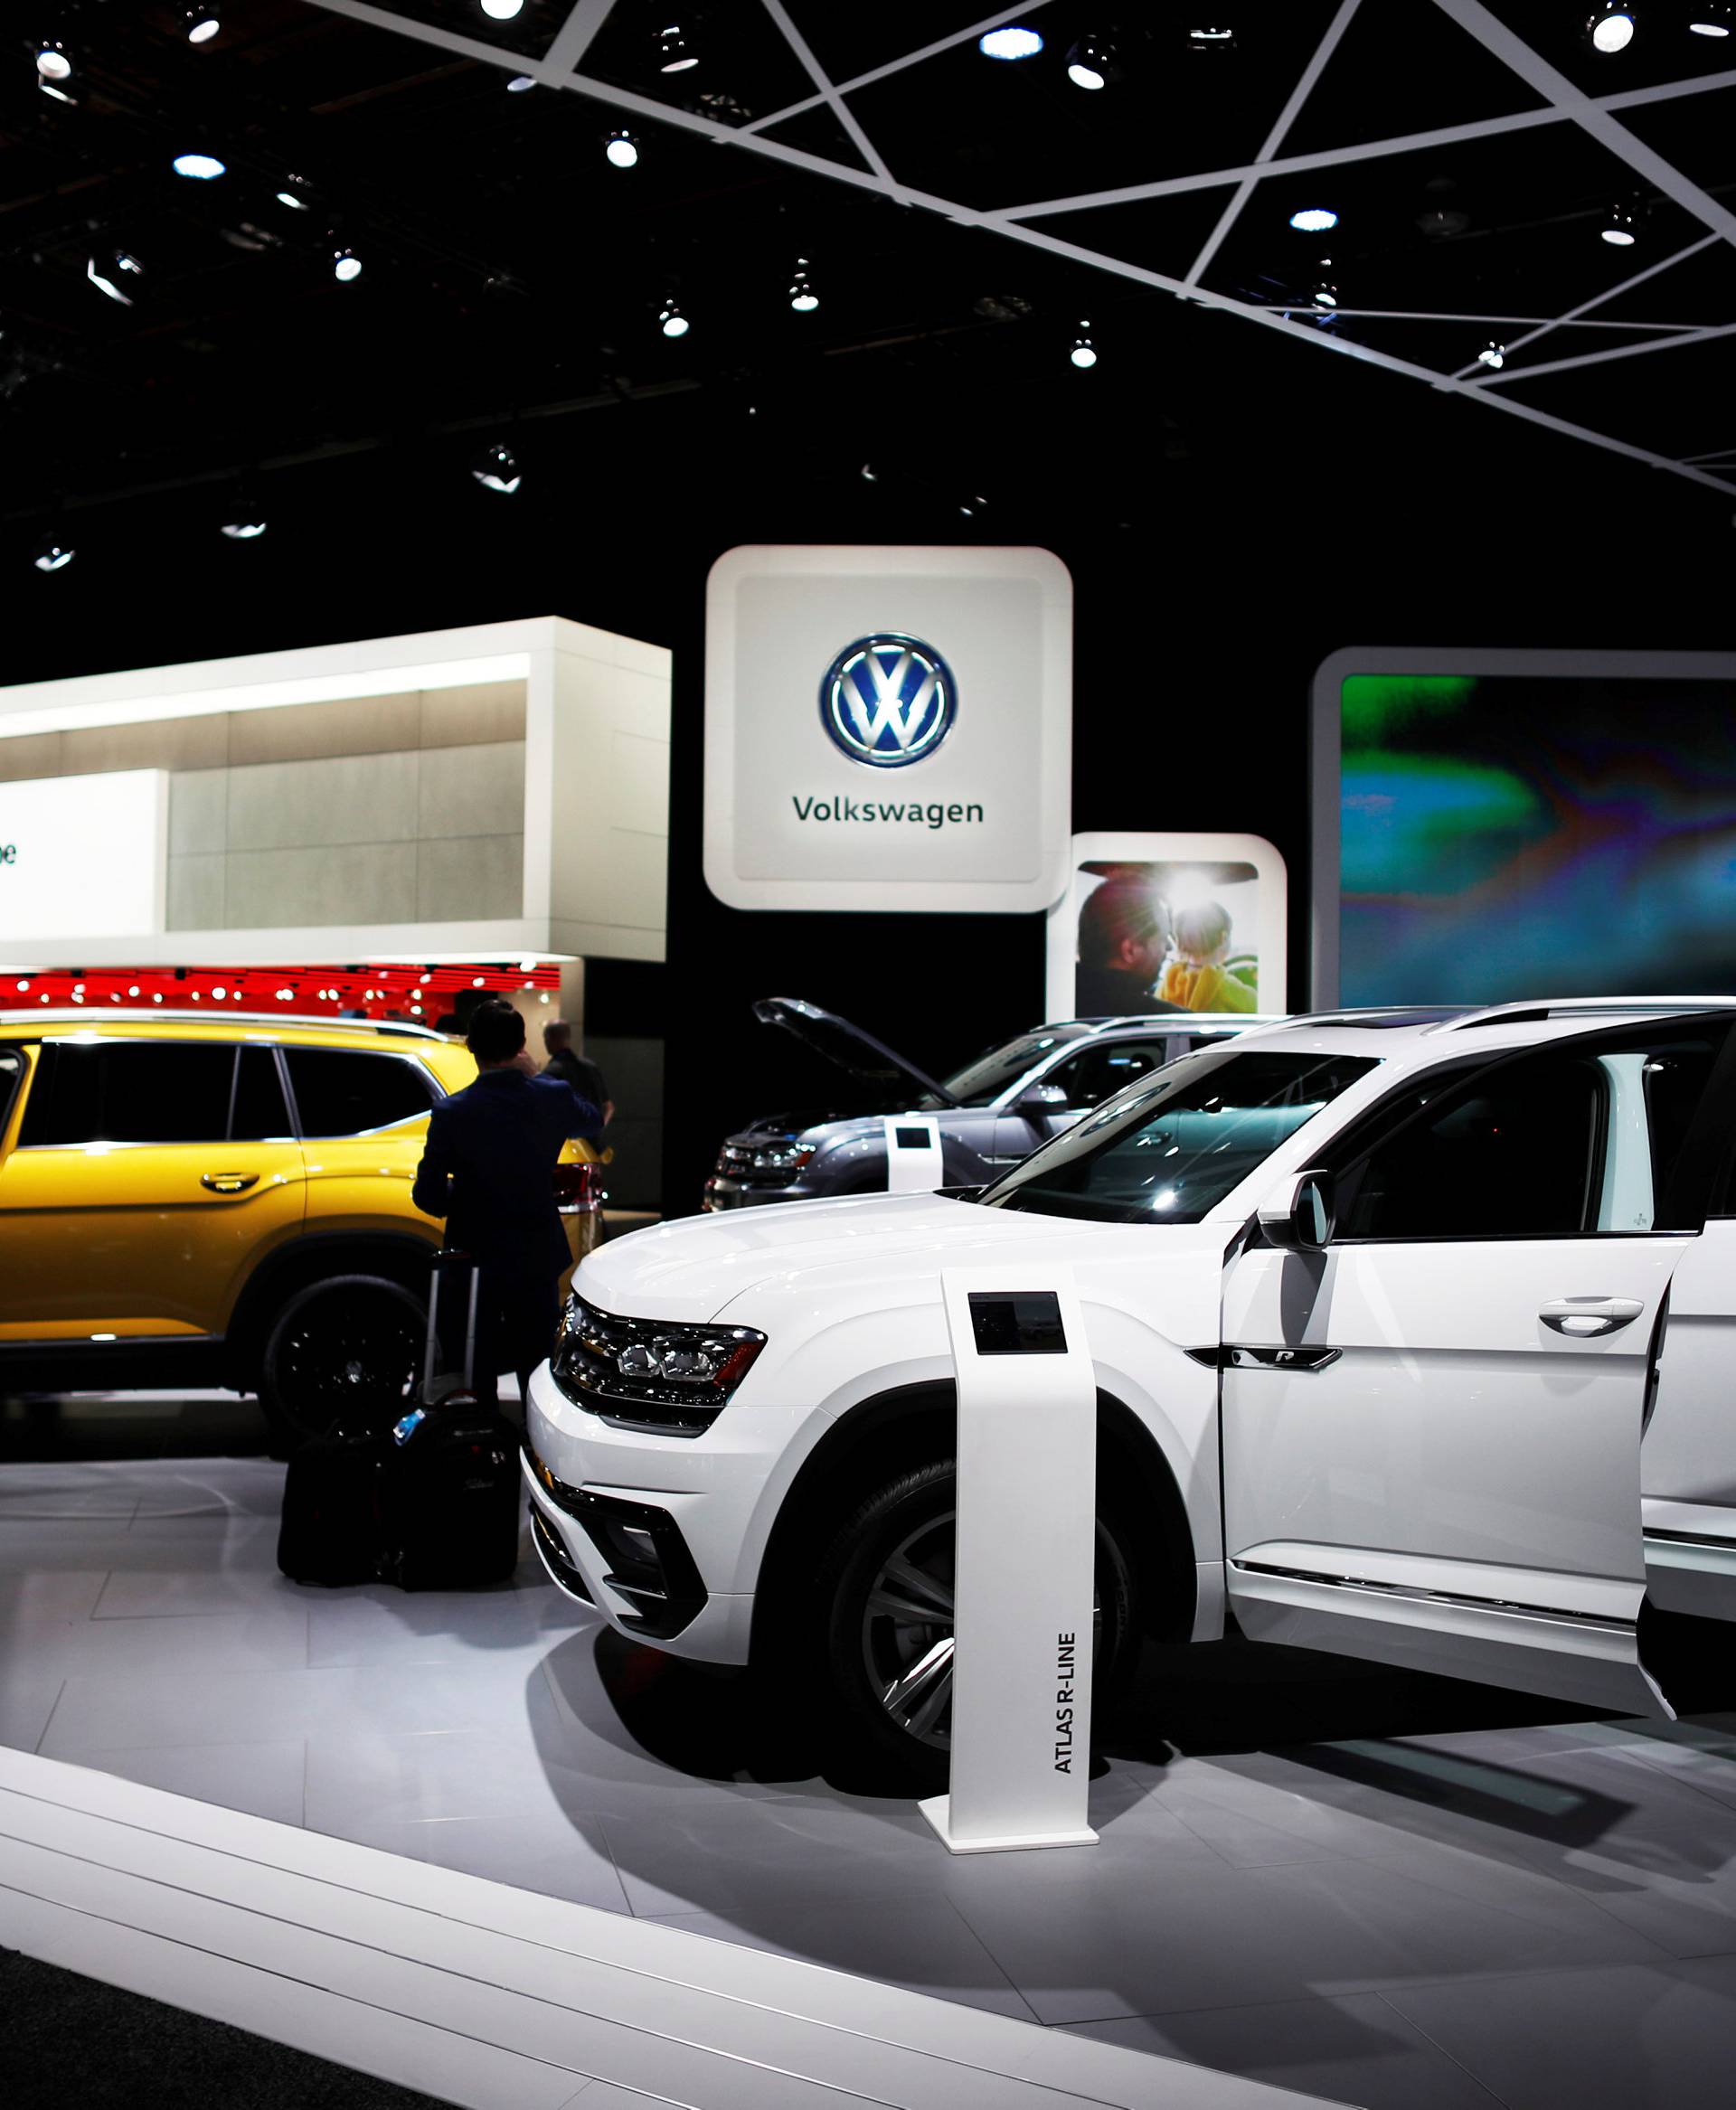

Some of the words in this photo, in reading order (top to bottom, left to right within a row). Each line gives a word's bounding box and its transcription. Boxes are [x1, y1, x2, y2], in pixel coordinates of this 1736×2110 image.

[792, 796, 984, 829] Volkswagen
[1056, 1632, 1075, 1703] R-LINE
[1054, 1708, 1074, 1775] ATLAS
